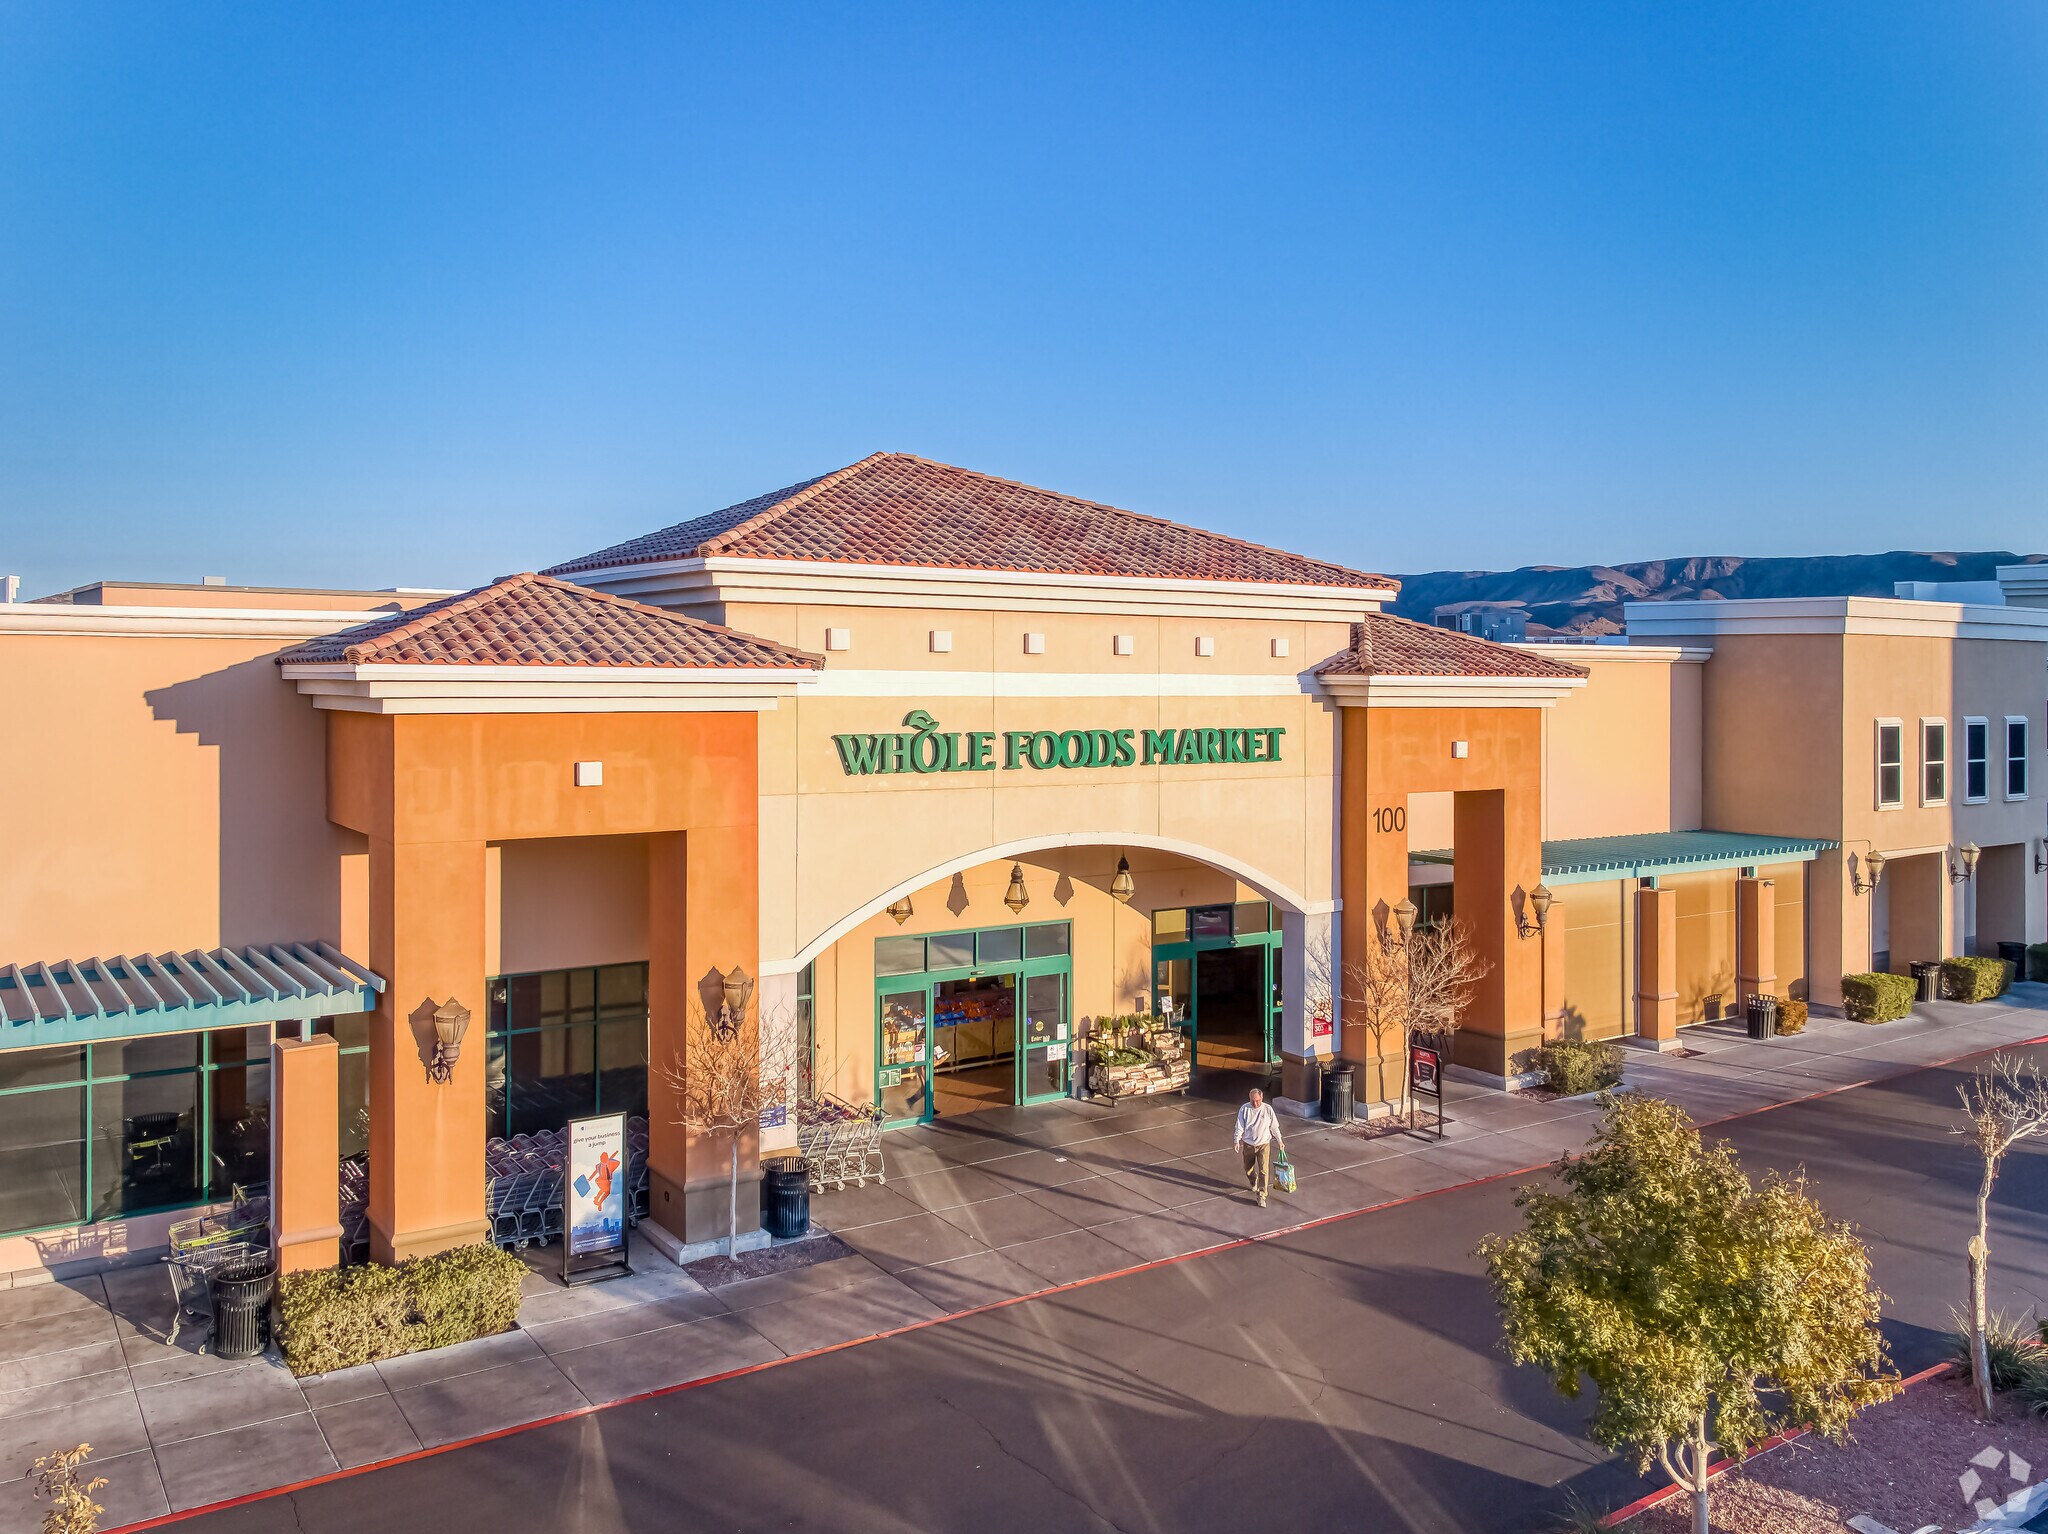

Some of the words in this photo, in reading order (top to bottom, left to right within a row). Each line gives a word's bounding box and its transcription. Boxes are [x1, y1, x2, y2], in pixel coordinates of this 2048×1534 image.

[831, 728, 996, 776] WHOLE
[1002, 728, 1136, 770] FOODS
[1140, 727, 1286, 765] MARKET
[1373, 807, 1406, 833] 100
[598, 1131, 621, 1139] business
[592, 1140, 606, 1149] jump
